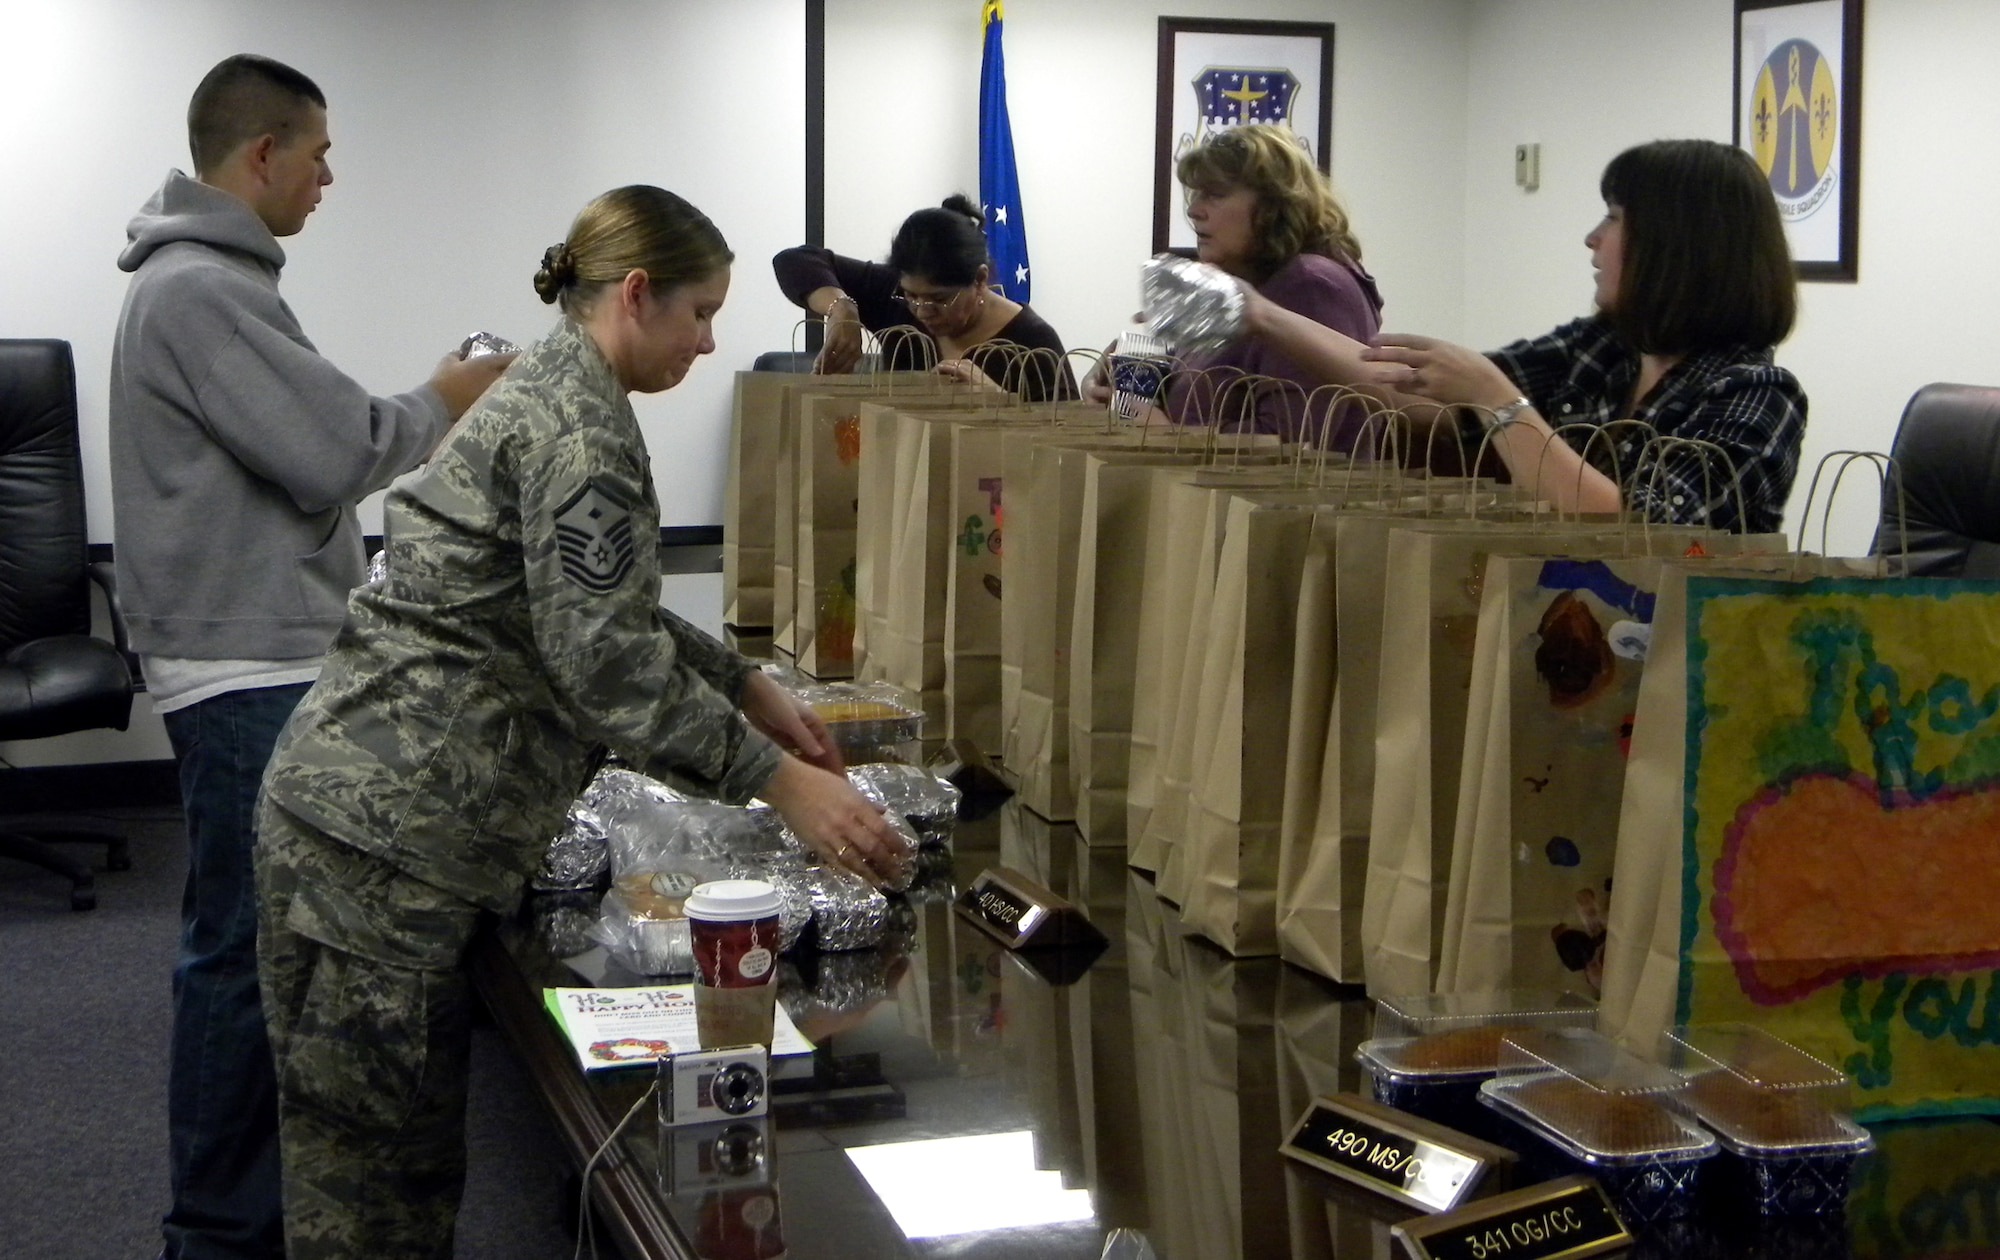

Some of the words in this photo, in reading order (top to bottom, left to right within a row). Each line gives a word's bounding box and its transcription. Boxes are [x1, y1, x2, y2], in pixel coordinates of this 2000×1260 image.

[1797, 175, 1832, 215] SQUADRON
[979, 891, 996, 907] 40
[988, 898, 1019, 923] HS/CC
[578, 1003, 645, 1013] HAPPY
[1326, 1128, 1368, 1157] 490
[1465, 1227, 1512, 1259] 341
[1511, 1206, 1582, 1245] OG/CC
